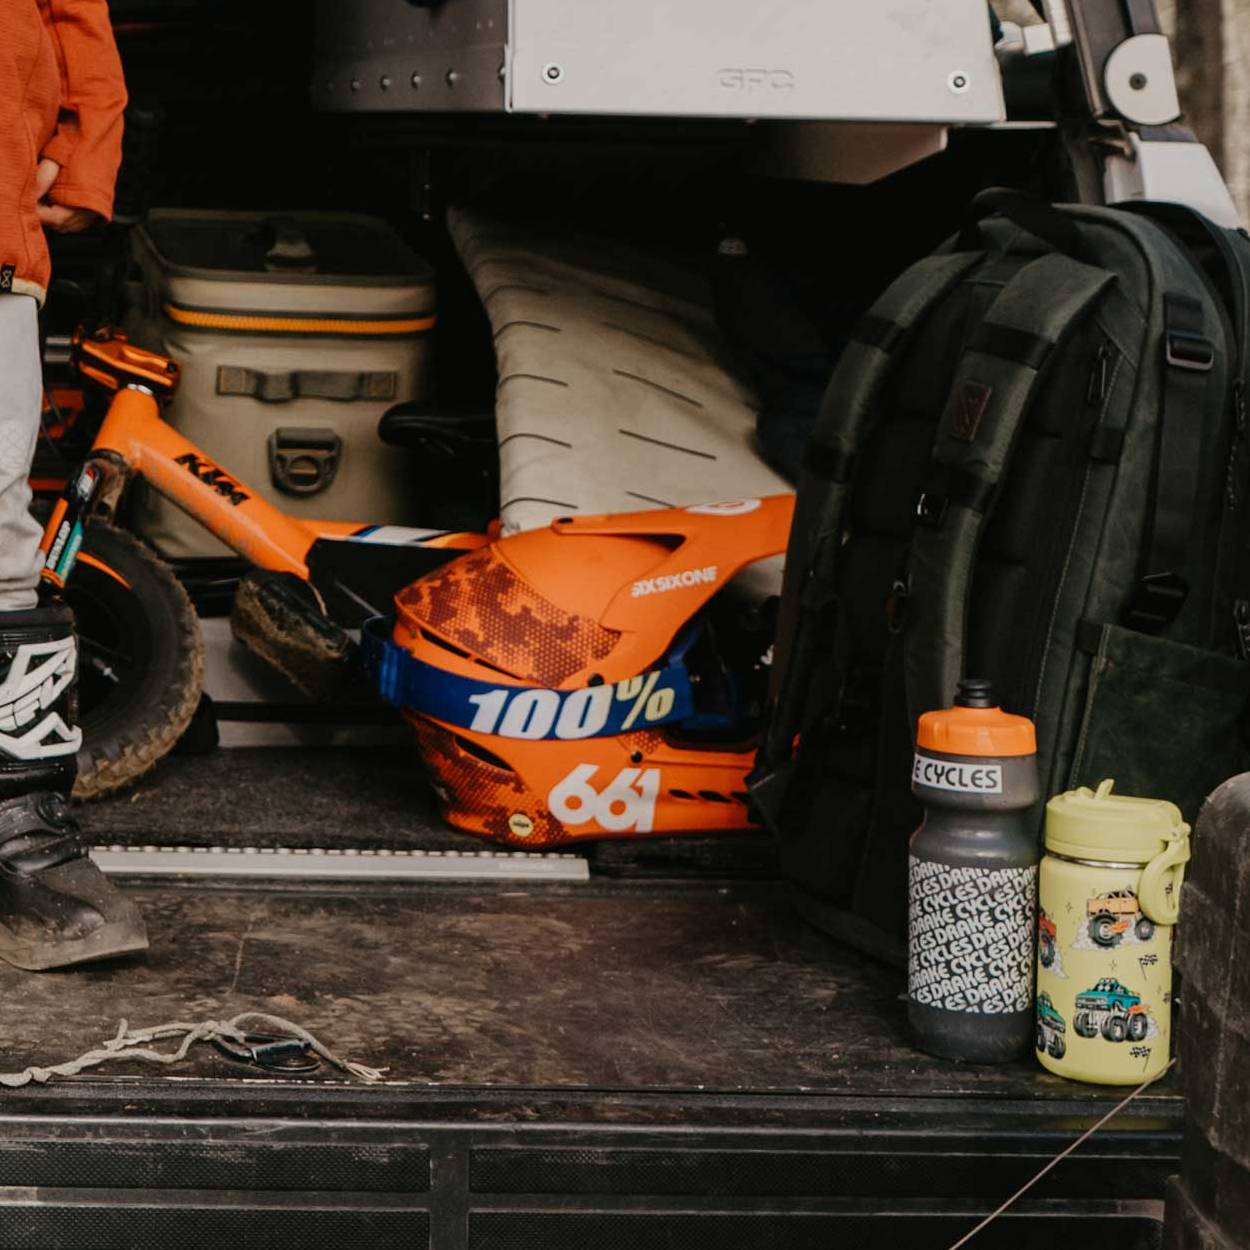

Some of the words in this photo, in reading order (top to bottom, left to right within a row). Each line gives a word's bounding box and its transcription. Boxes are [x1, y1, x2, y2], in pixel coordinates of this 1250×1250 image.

[718, 67, 796, 91] GFC
[174, 453, 250, 506] KTM
[631, 565, 718, 598] SIXSIXONE
[468, 669, 676, 740] 100%
[924, 763, 998, 789] CYCLES
[548, 763, 661, 833] 661
